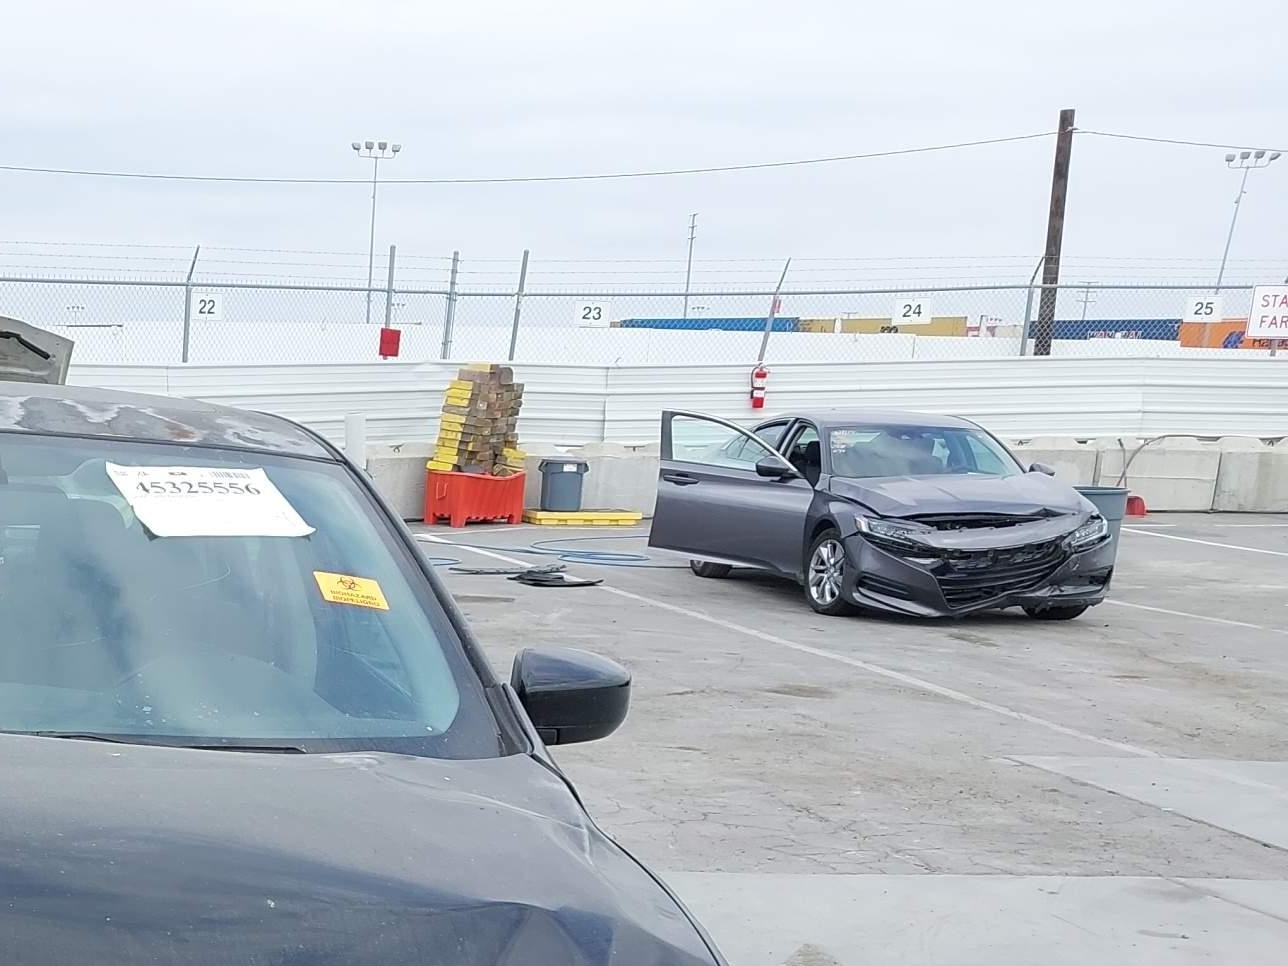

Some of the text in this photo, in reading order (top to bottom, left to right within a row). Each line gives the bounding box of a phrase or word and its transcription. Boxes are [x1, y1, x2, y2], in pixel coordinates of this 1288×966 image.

[198, 299, 216, 314] 22
[582, 306, 602, 320] 23
[902, 303, 923, 318] 24
[1193, 302, 1214, 316] 25
